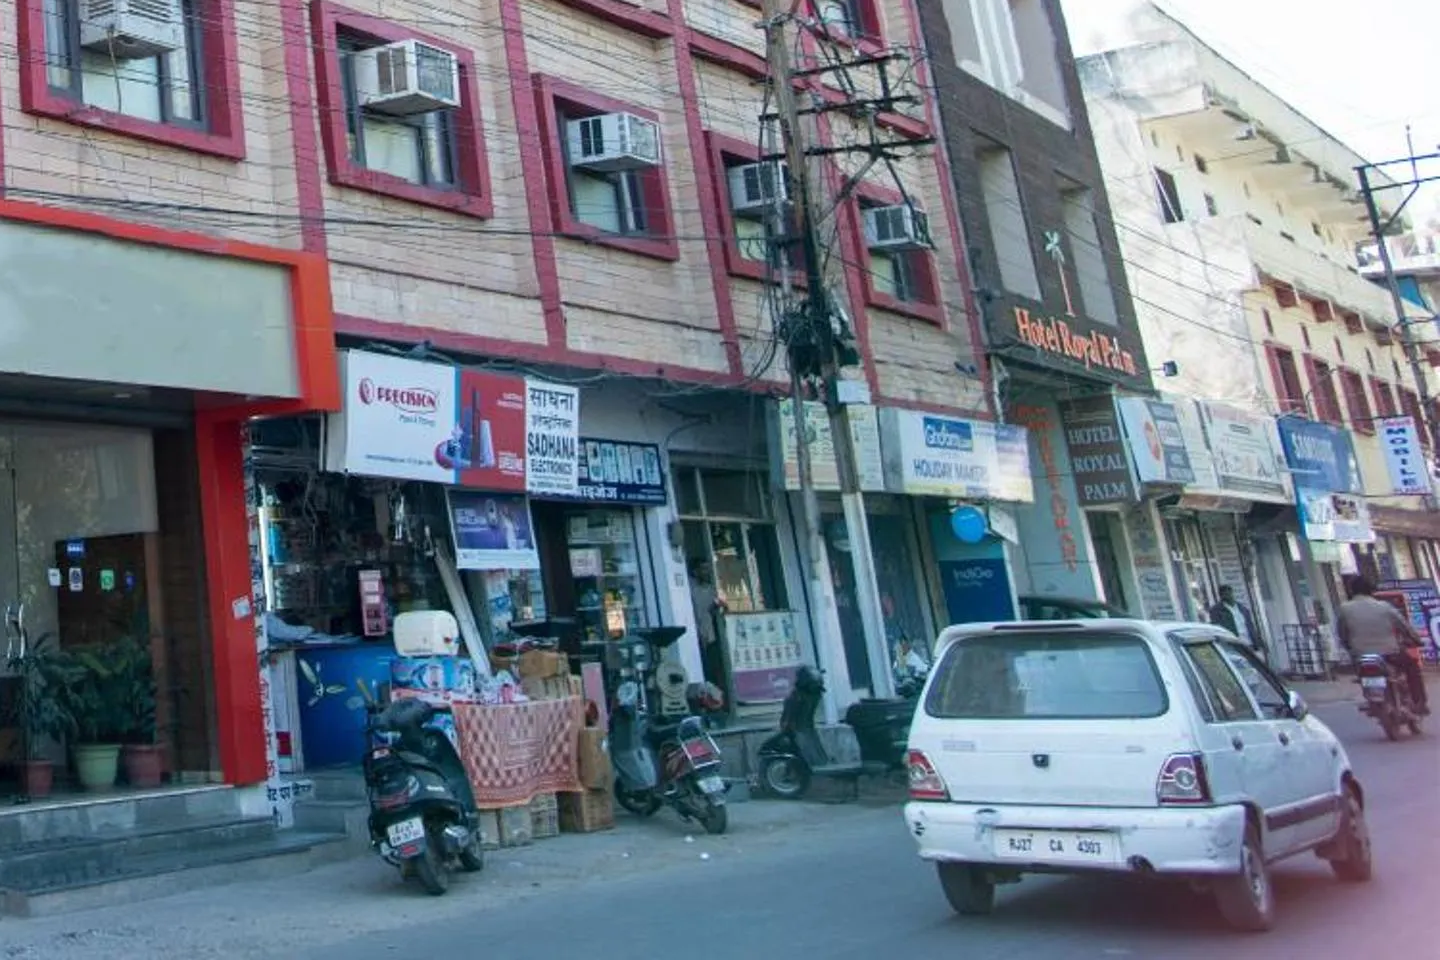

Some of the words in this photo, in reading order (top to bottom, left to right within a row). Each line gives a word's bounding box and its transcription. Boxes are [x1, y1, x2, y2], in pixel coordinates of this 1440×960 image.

[1014, 306, 1061, 353] Hotel
[1057, 319, 1102, 371] Royal
[1097, 333, 1137, 376] Palm
[377, 386, 437, 409] PRECISION
[527, 432, 575, 460] SADHANA
[1068, 425, 1120, 445] HOTEL
[531, 458, 573, 477] ELECTRONICS
[1073, 453, 1126, 473] ROYAL
[1386, 427, 1417, 486] MOBILE
[913, 458, 954, 480] HOLIDAY
[1084, 482, 1129, 501] PALM
